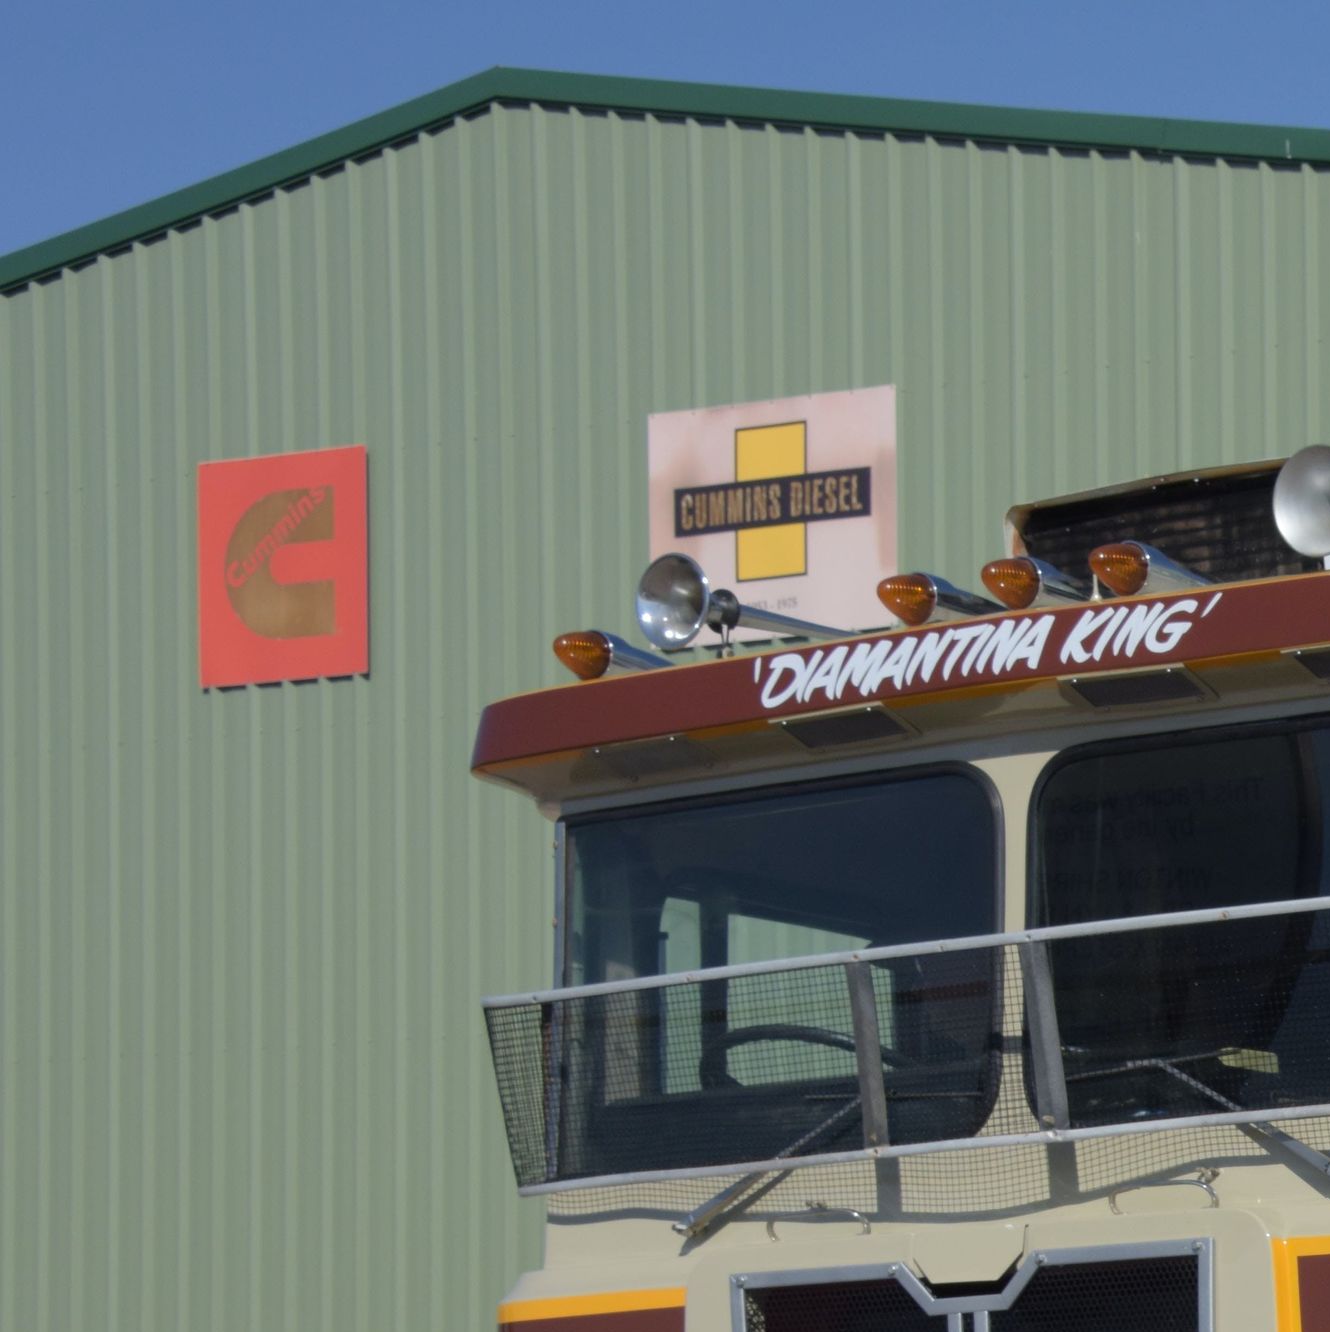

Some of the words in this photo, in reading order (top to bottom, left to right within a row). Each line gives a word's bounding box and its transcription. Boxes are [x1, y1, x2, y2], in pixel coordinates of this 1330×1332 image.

[226, 486, 326, 588] Cummins
[681, 483, 781, 530] CUMMINS
[790, 475, 863, 517] DIESEL
